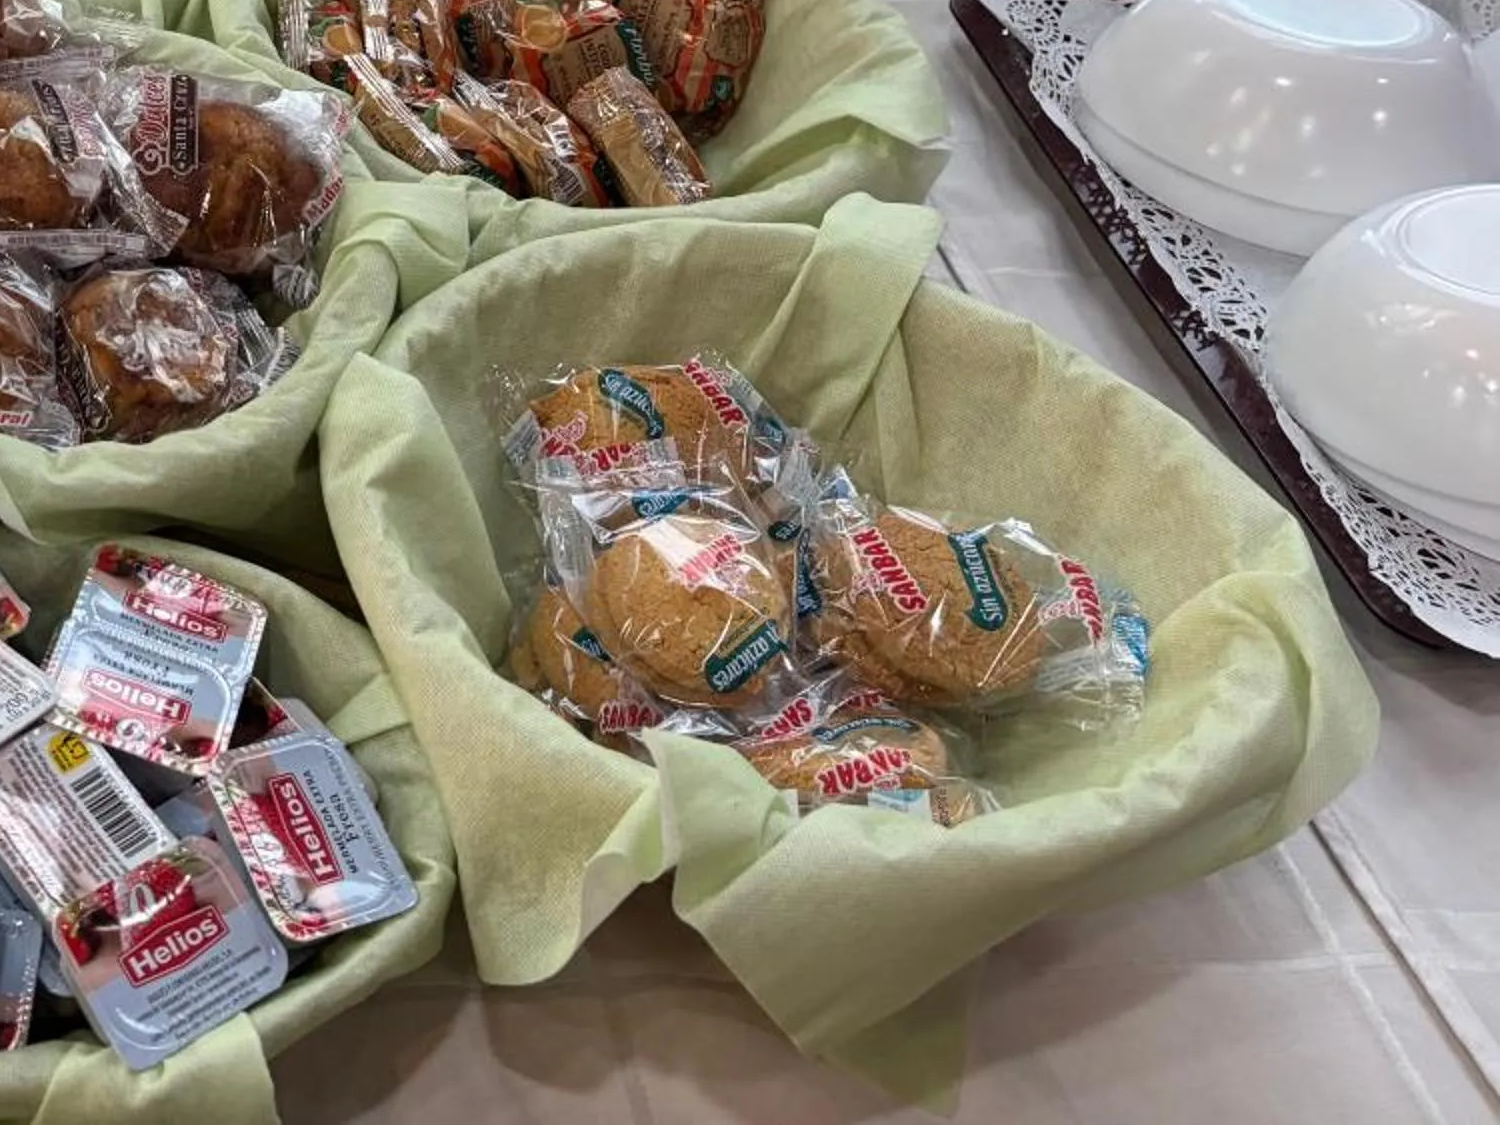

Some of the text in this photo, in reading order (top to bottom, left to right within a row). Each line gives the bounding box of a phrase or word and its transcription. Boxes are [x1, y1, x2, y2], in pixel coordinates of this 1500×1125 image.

[174, 116, 188, 161] Santa
[854, 529, 927, 612] SANBAR
[132, 597, 218, 639] Helios
[979, 599, 1001, 622] Sin
[711, 635, 769, 691] azúcares
[90, 672, 181, 719] Helios
[281, 782, 335, 875] Helios
[303, 769, 359, 874] MERMELADA EXTRA
[329, 793, 360, 843] Fresa
[128, 916, 219, 979] Helios
